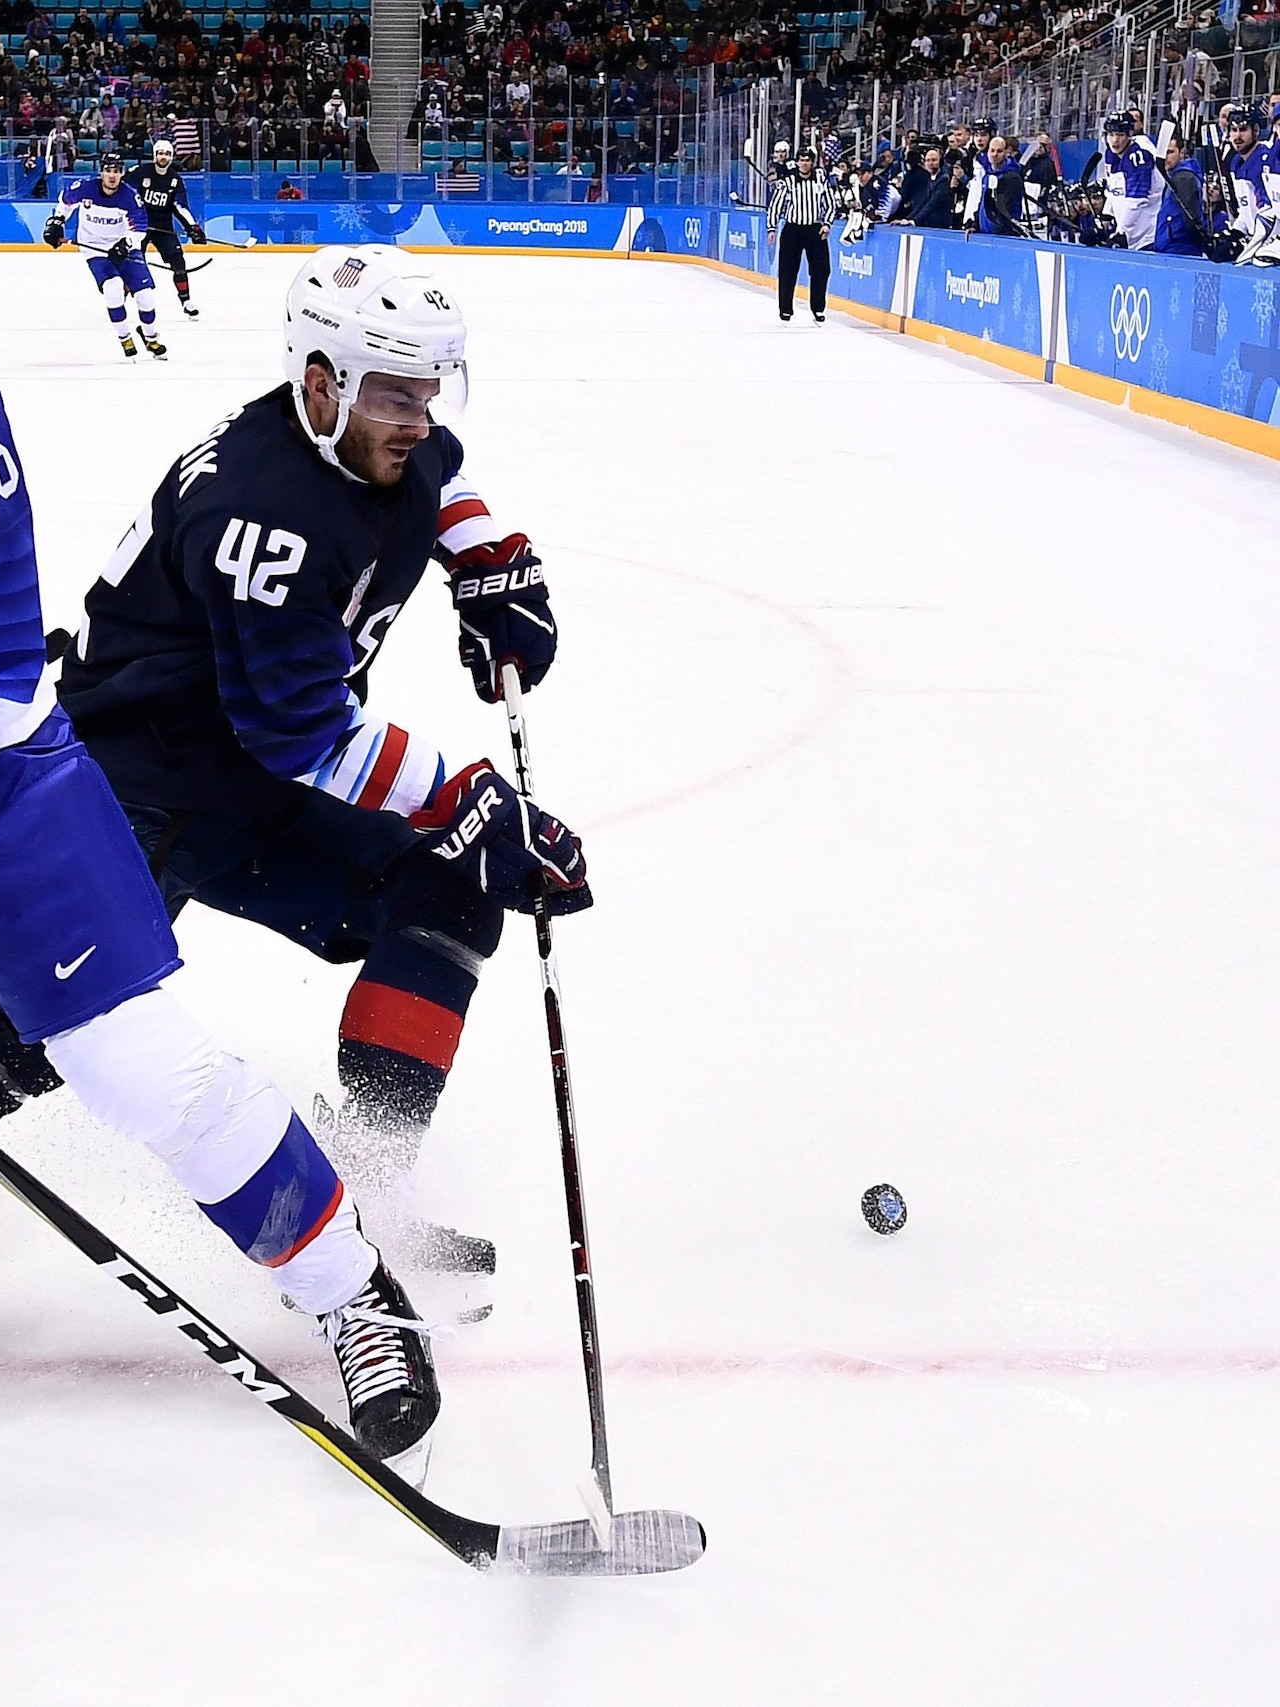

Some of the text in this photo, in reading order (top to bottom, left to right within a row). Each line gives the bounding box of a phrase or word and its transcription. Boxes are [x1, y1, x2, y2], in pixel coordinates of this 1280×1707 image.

[1129, 150, 1146, 167] 71
[143, 188, 168, 207] USA
[487, 218, 588, 236] PyeongChang 2018
[423, 289, 451, 311] 42
[301, 308, 341, 331] BAUER
[215, 517, 308, 607] 42
[96, 1252, 292, 1403] CCM
